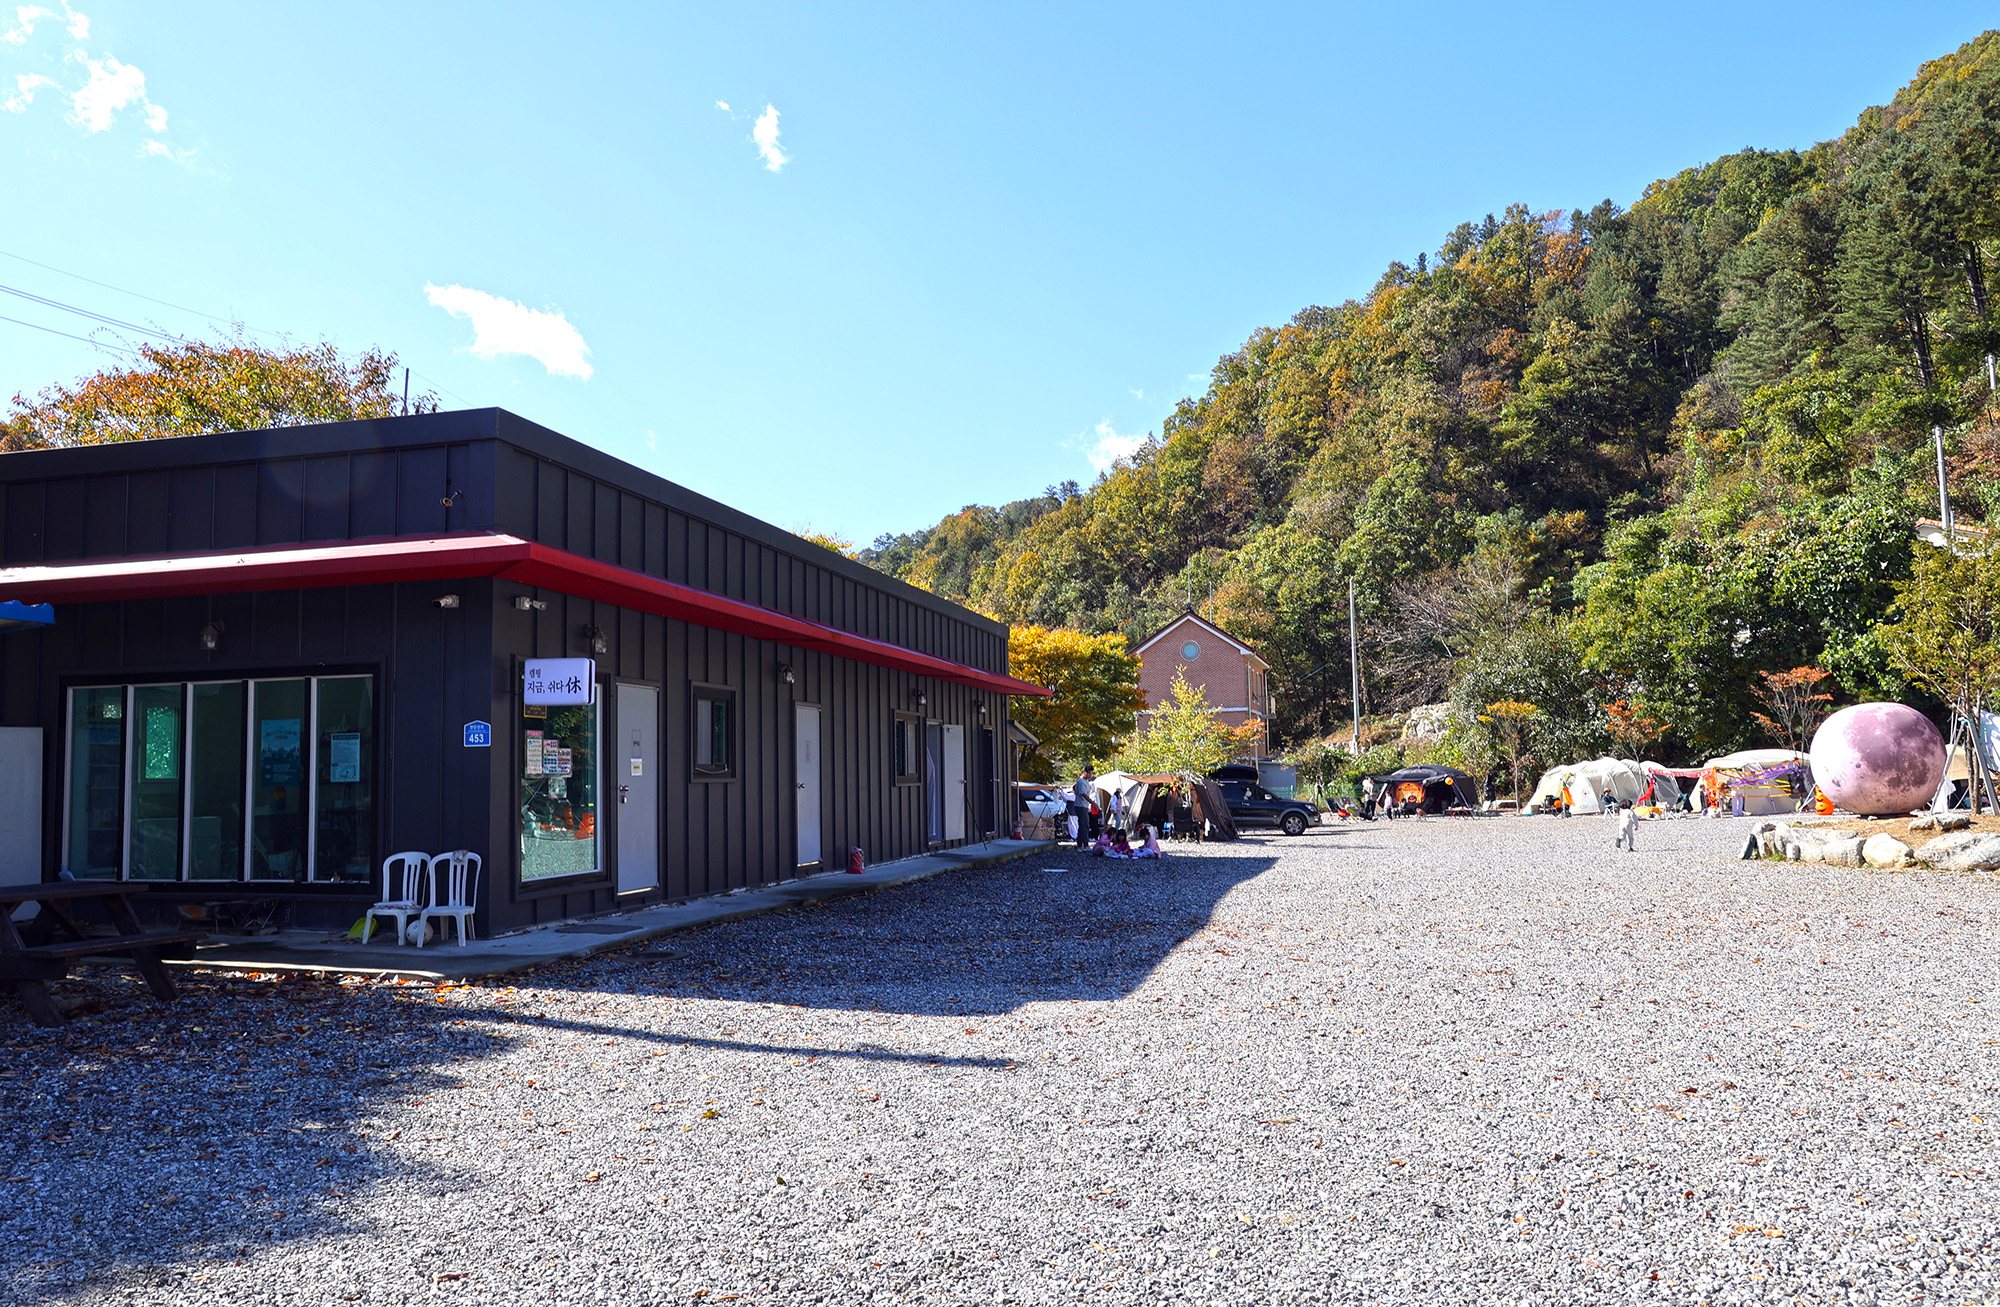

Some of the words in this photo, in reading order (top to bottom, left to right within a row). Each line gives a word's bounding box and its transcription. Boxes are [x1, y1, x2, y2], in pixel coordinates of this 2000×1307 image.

[529, 668, 541, 678] 캠핑
[527, 681, 545, 694] 지금,
[548, 680, 564, 693] 쉬다
[565, 675, 582, 694] 休
[469, 733, 484, 743] 453
